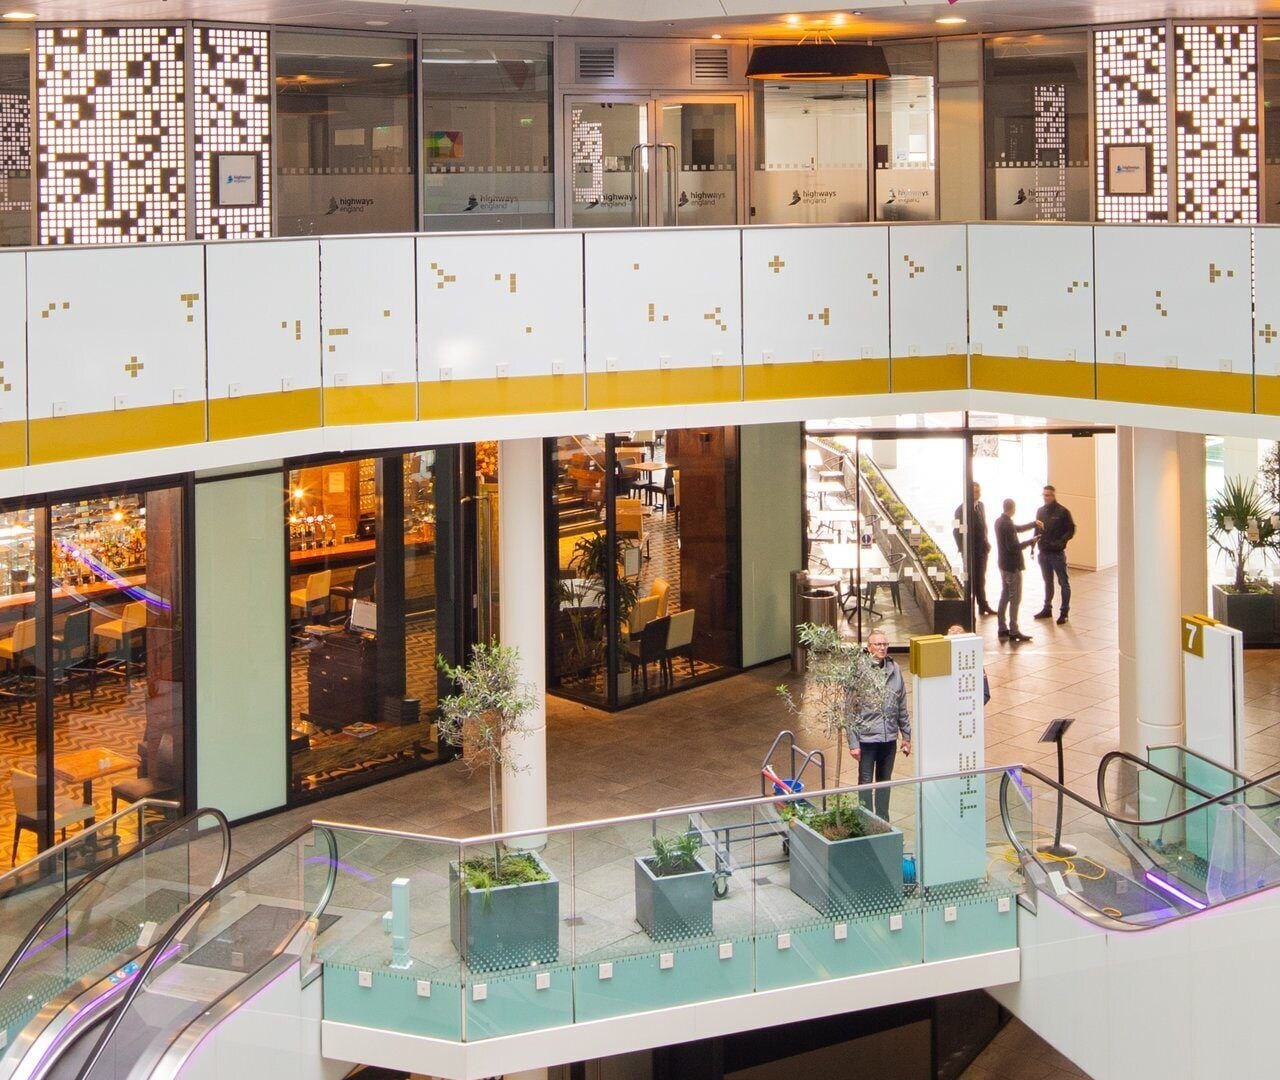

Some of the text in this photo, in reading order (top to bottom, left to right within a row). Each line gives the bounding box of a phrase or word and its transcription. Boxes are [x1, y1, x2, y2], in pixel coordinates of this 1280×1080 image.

[339, 197, 374, 207] highways
[802, 190, 837, 199] highways
[1185, 623, 1197, 649] 7
[958, 650, 977, 818] THE CUBE
